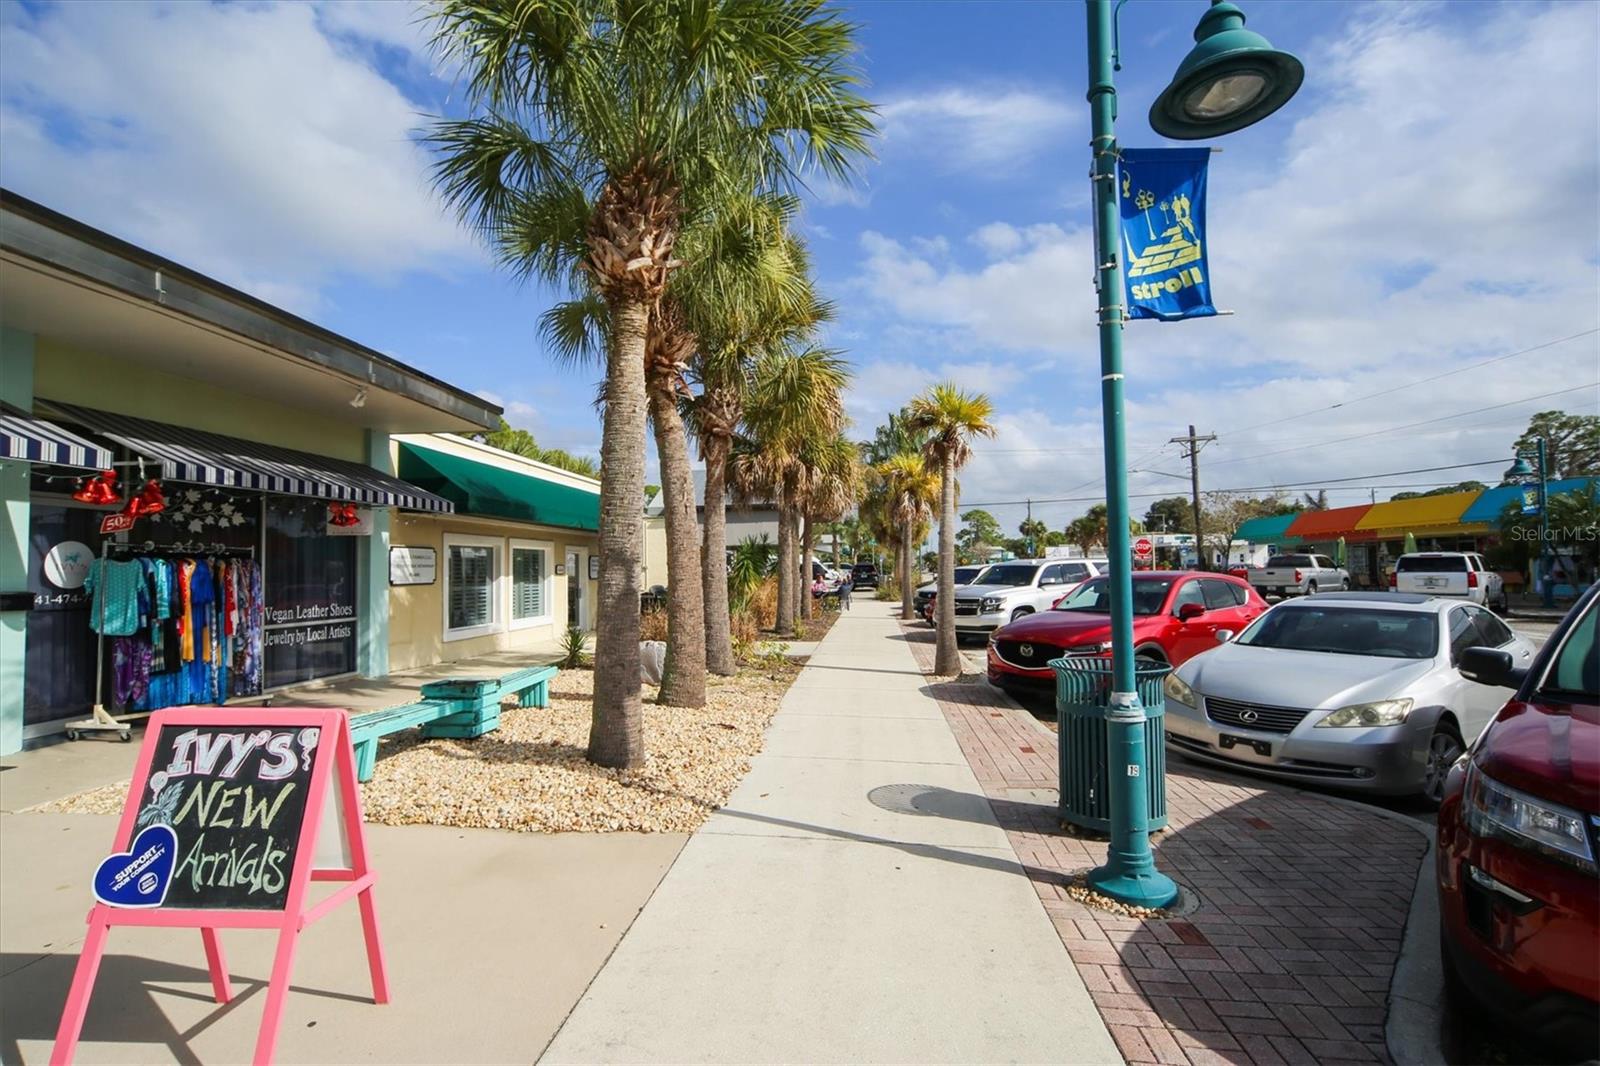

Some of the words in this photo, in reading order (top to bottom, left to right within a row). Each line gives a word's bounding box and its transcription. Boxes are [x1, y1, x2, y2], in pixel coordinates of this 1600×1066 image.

[1131, 267, 1203, 300] stroll
[264, 607, 294, 623] Vegan
[296, 604, 329, 619] Leather
[330, 603, 353, 616] Shoes
[264, 630, 295, 646] Jewelry
[296, 629, 305, 645] by
[307, 626, 327, 641] Local
[329, 625, 351, 639] Artists
[167, 729, 299, 780] IVY'S
[173, 780, 296, 829] NEW
[112, 876, 131, 892] YOUR
[130, 847, 165, 878] COMMUNITY
[115, 845, 156, 882] SUPPORT
[174, 833, 287, 895] Arrivals
